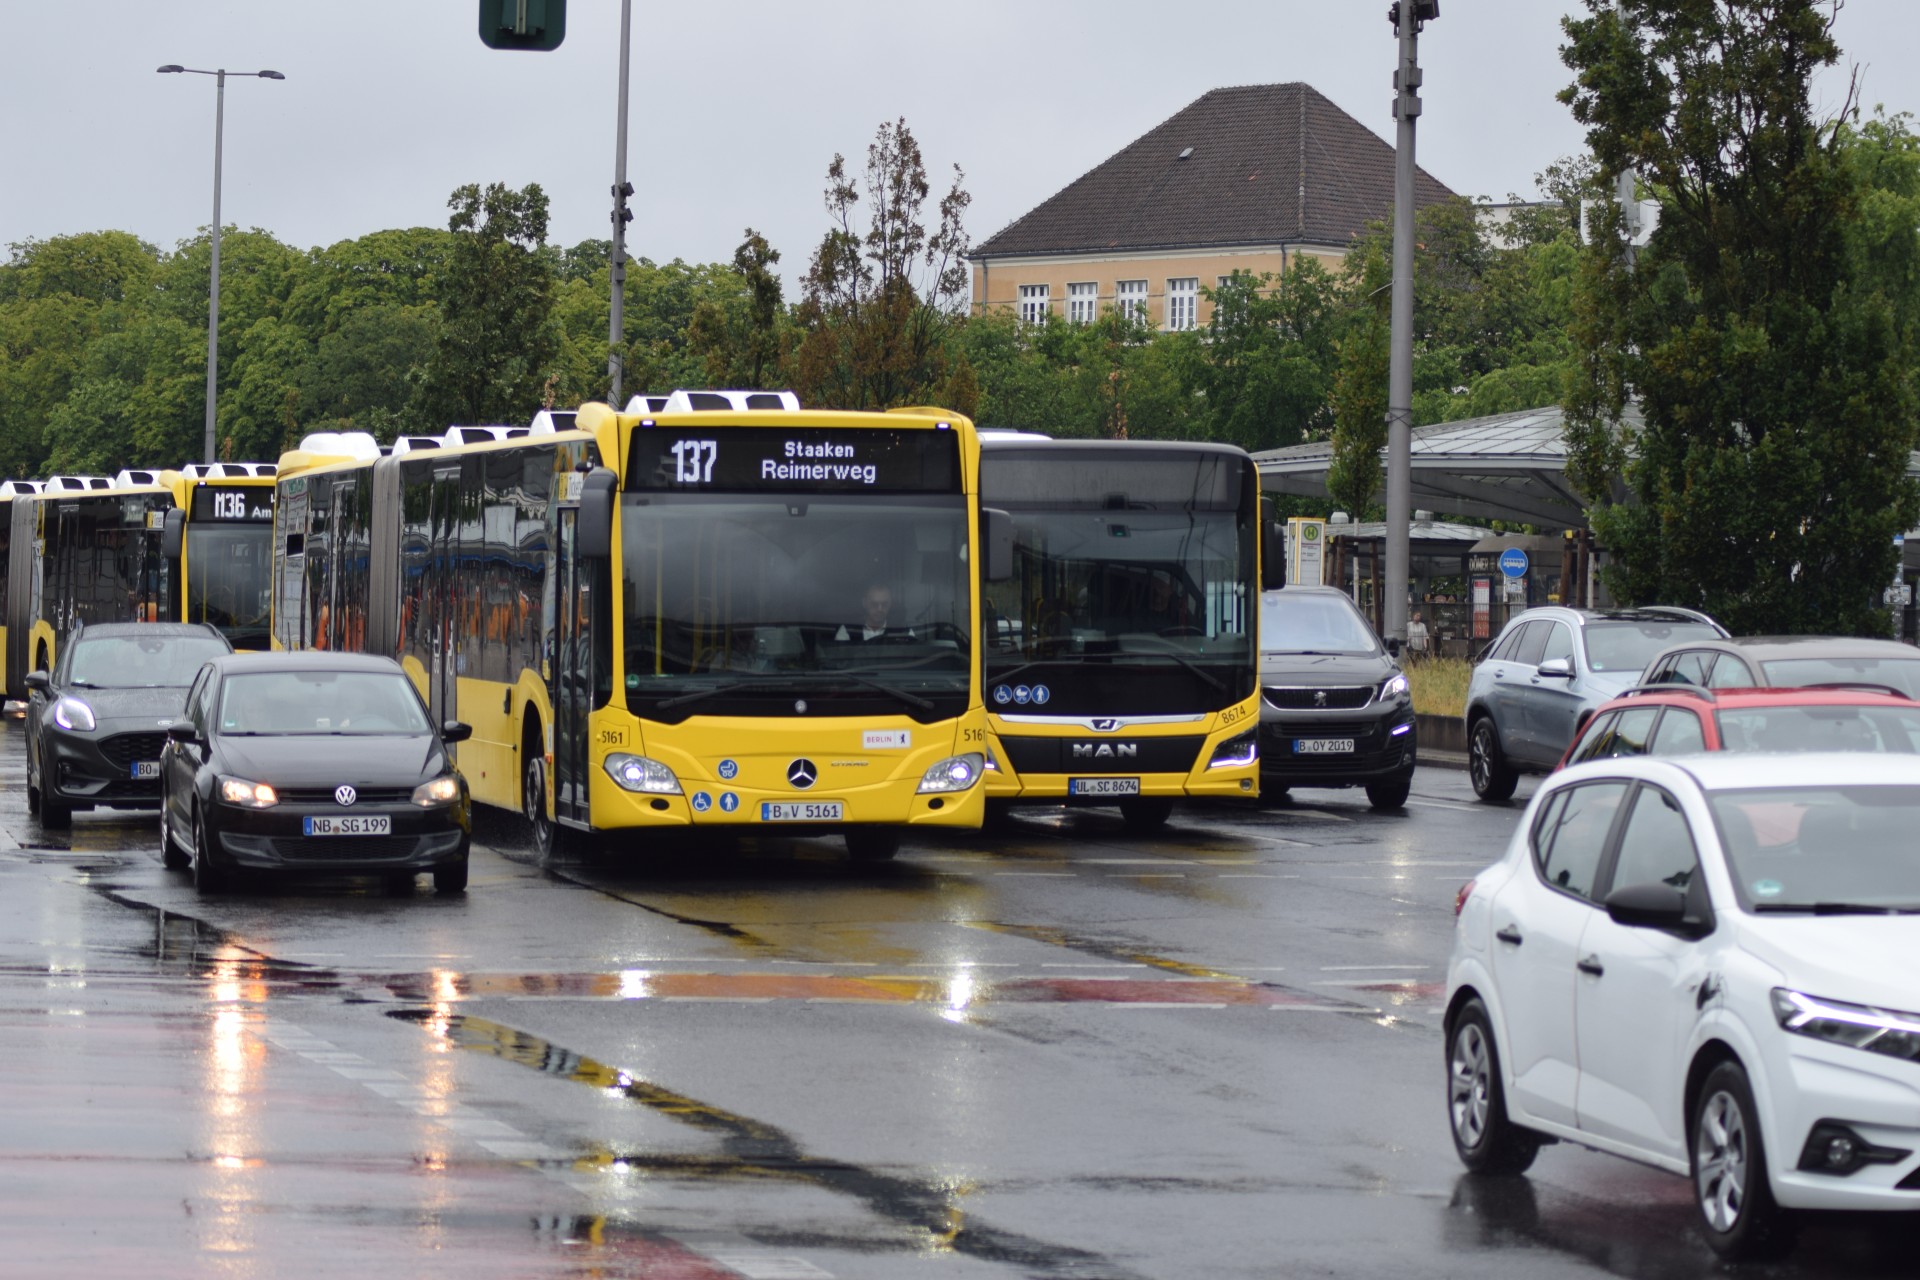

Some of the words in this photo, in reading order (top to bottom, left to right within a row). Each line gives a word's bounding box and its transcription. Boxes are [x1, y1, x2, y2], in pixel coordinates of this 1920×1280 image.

[785, 441, 854, 457] Staaken
[671, 440, 717, 482] 137
[762, 460, 876, 484] Reimerweg
[215, 493, 245, 518] M36
[252, 506, 272, 518] Am
[1222, 705, 1246, 724] 8674
[602, 731, 623, 744] 5161
[1073, 743, 1137, 758] MAN
[1328, 741, 1353, 751] 2019
[1076, 782, 1089, 793] UL
[1097, 781, 1110, 792] SC
[1112, 780, 1137, 792] 8674
[773, 805, 782, 818] B
[791, 805, 799, 818] V
[806, 805, 839, 818] 5161
[313, 819, 331, 833] NB
[341, 819, 359, 832] SG
[362, 818, 388, 832] 199
